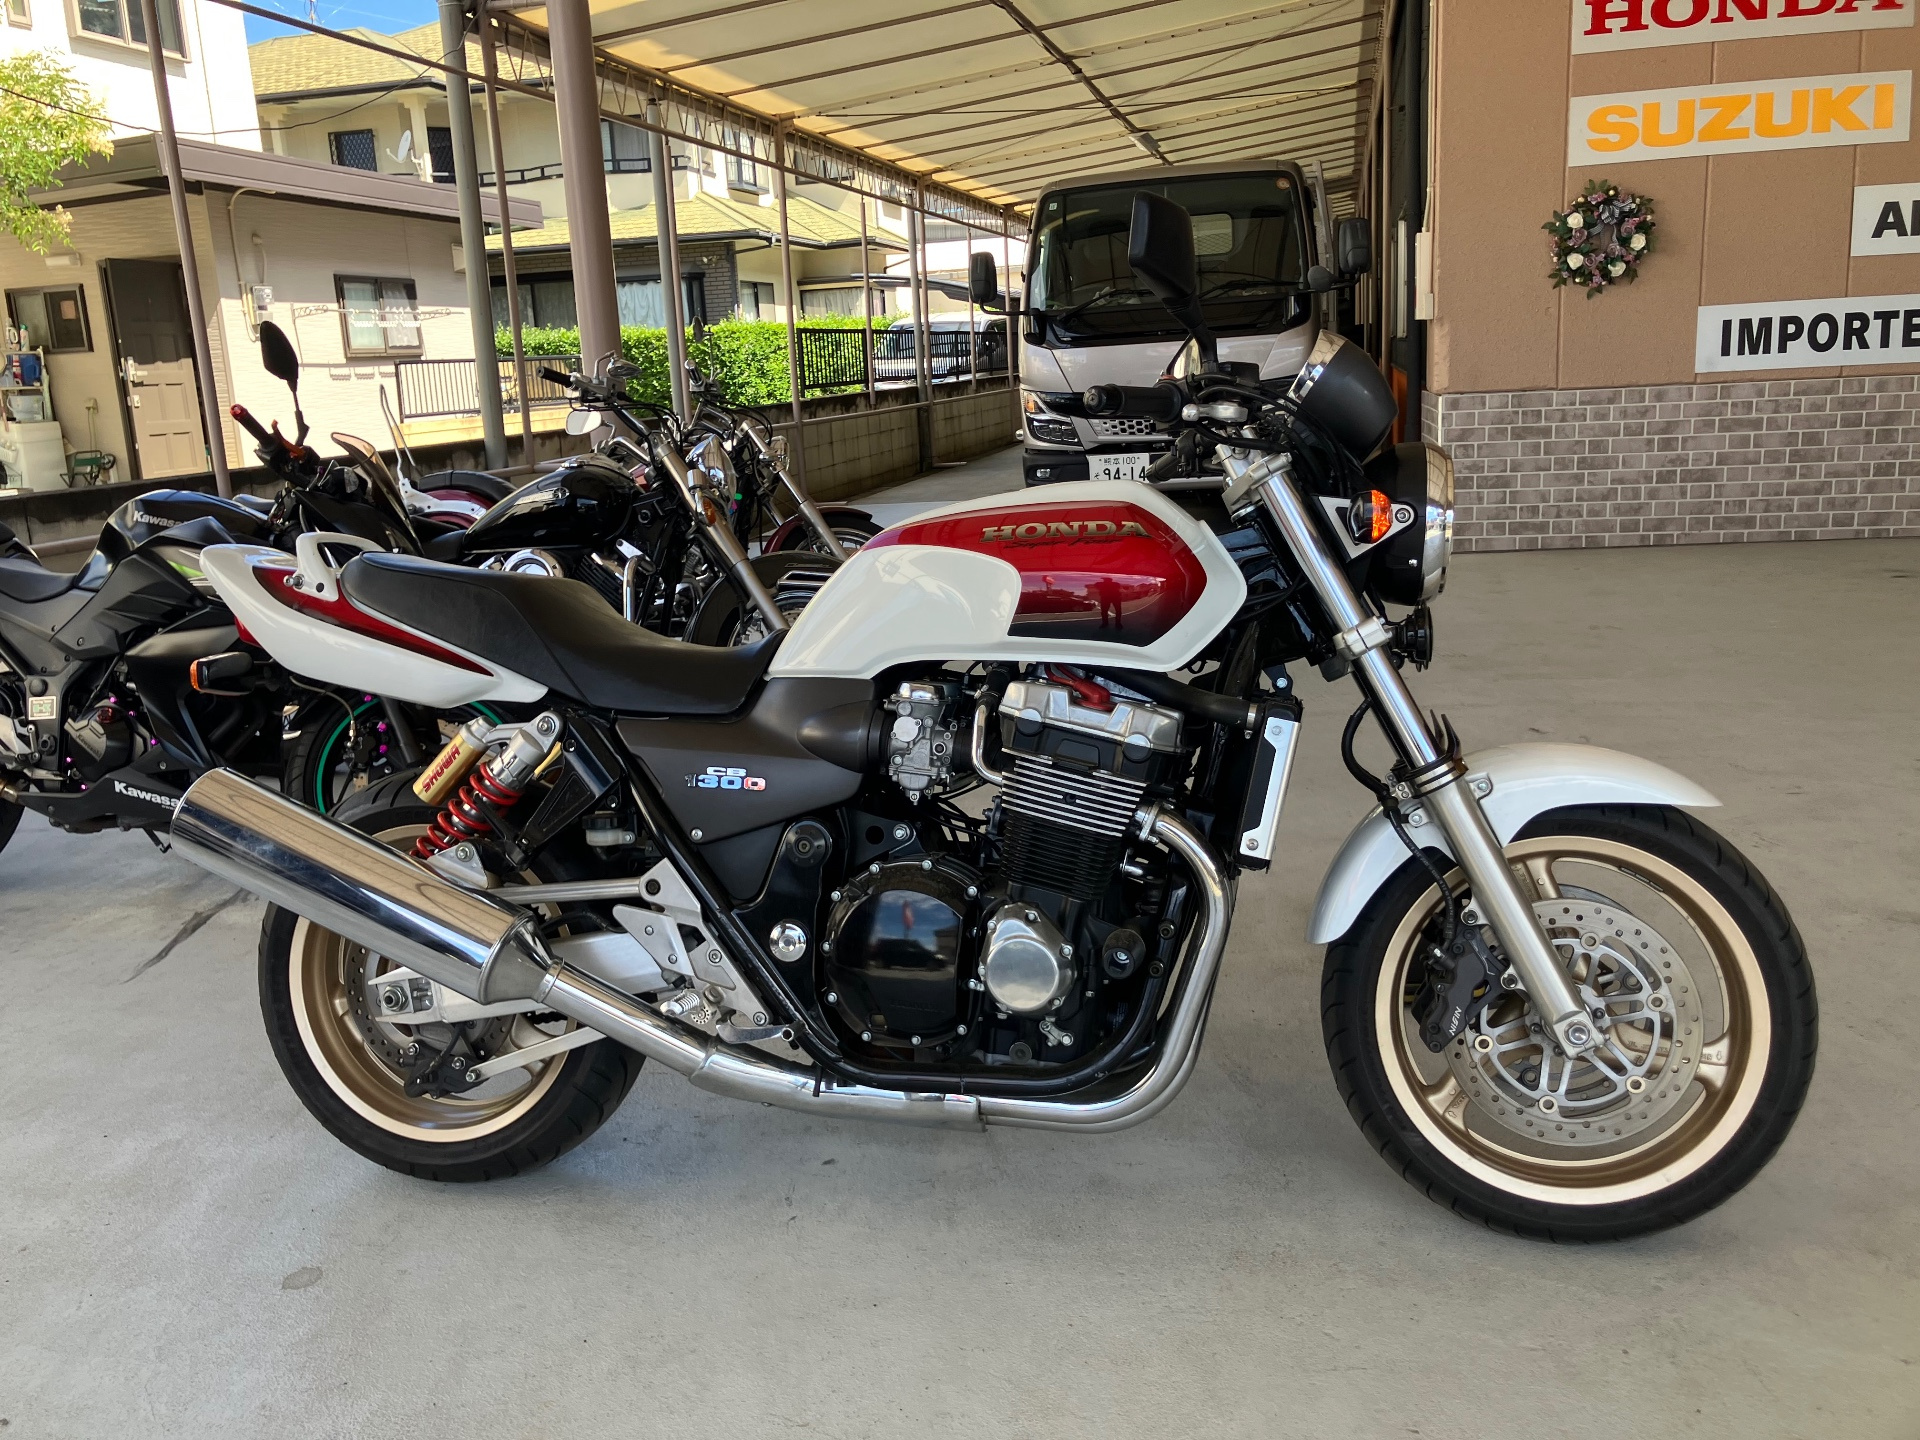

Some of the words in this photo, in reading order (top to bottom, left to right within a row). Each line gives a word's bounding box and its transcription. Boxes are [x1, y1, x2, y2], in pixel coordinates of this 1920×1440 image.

[1586, 83, 1896, 152] SUZUKI
[1720, 309, 1920, 357] IMPORTE
[1103, 466, 1147, 481] 94-14
[979, 520, 1153, 543] HONDA
[422, 743, 461, 793] SHOWA
[706, 766, 747, 777] CB
[114, 780, 180, 808] Kawasa
[684, 773, 766, 791] 1300
